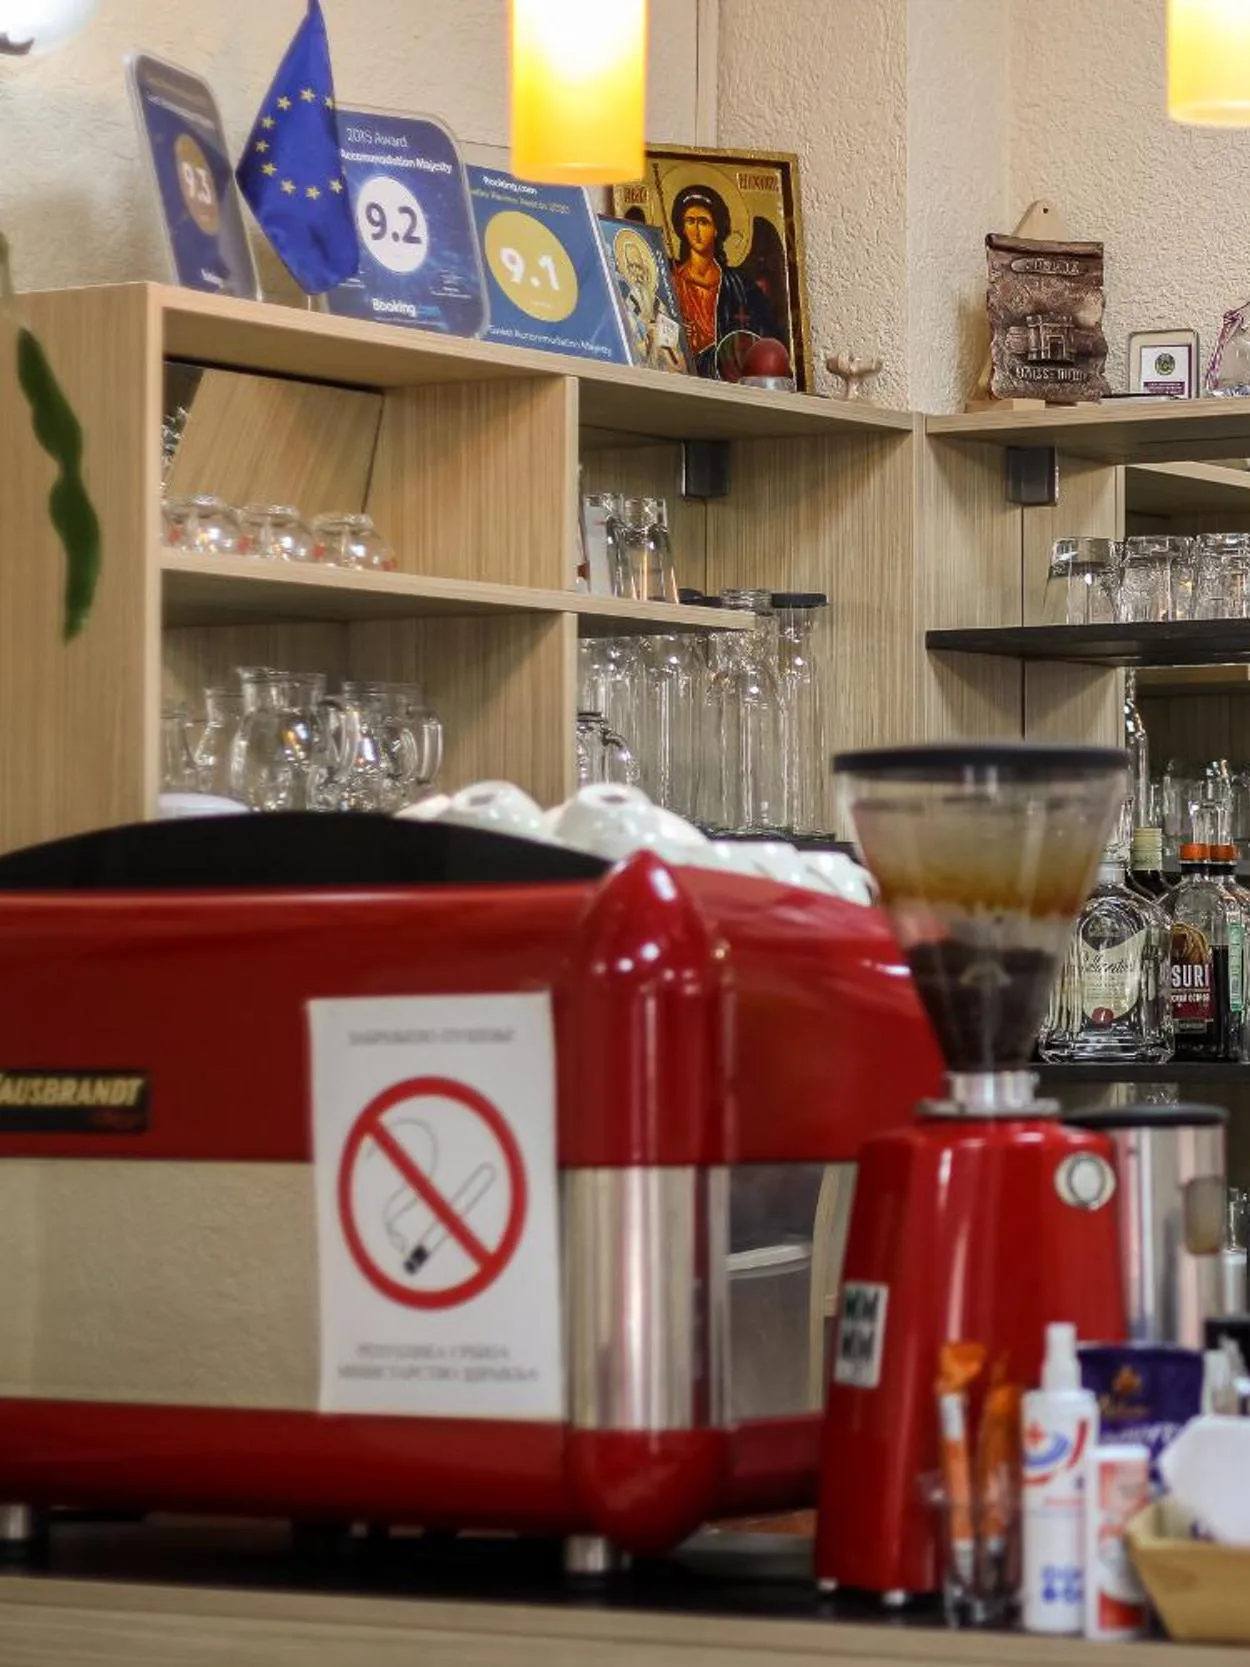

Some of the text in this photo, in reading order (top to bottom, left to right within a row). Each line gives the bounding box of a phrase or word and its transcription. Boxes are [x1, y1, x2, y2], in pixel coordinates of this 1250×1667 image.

[365, 202, 422, 244] 9.2
[500, 247, 560, 291] 9.1
[372, 298, 441, 318] Booking
[0, 1074, 144, 1107] AUSBRANDT
